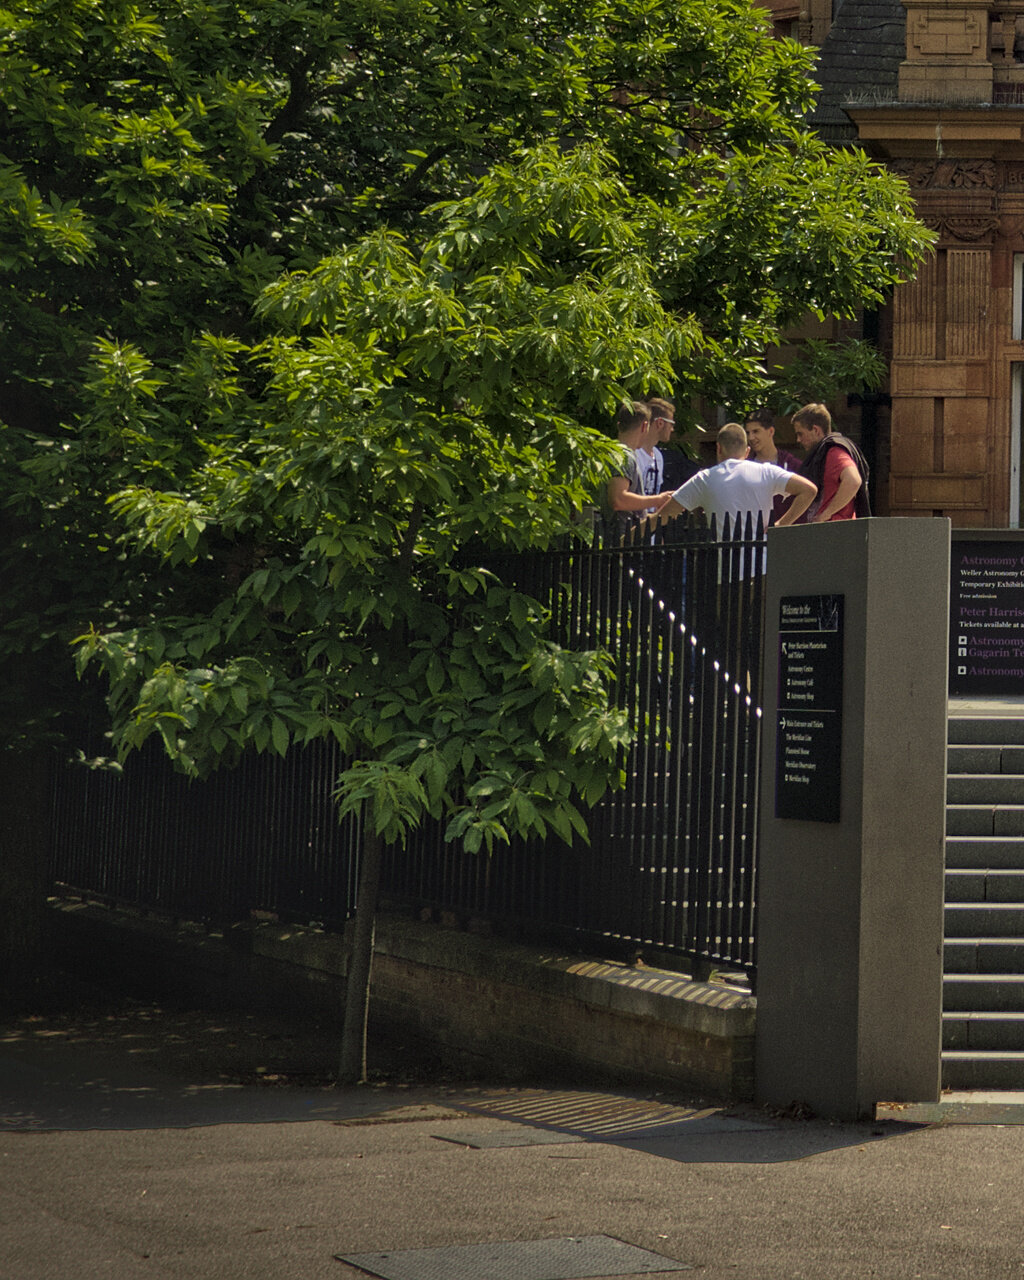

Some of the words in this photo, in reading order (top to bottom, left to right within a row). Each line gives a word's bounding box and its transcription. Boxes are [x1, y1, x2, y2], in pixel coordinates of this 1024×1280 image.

[960, 555, 1018, 567] Astronomy
[960, 569, 982, 577] Weller
[984, 570, 1018, 578] Astronomy
[960, 580, 995, 589] Temporary
[960, 607, 987, 616] Peter
[970, 636, 1024, 647] Astronomy
[968, 648, 1010, 659] Gagarin
[968, 666, 1024, 677] Astronomy
